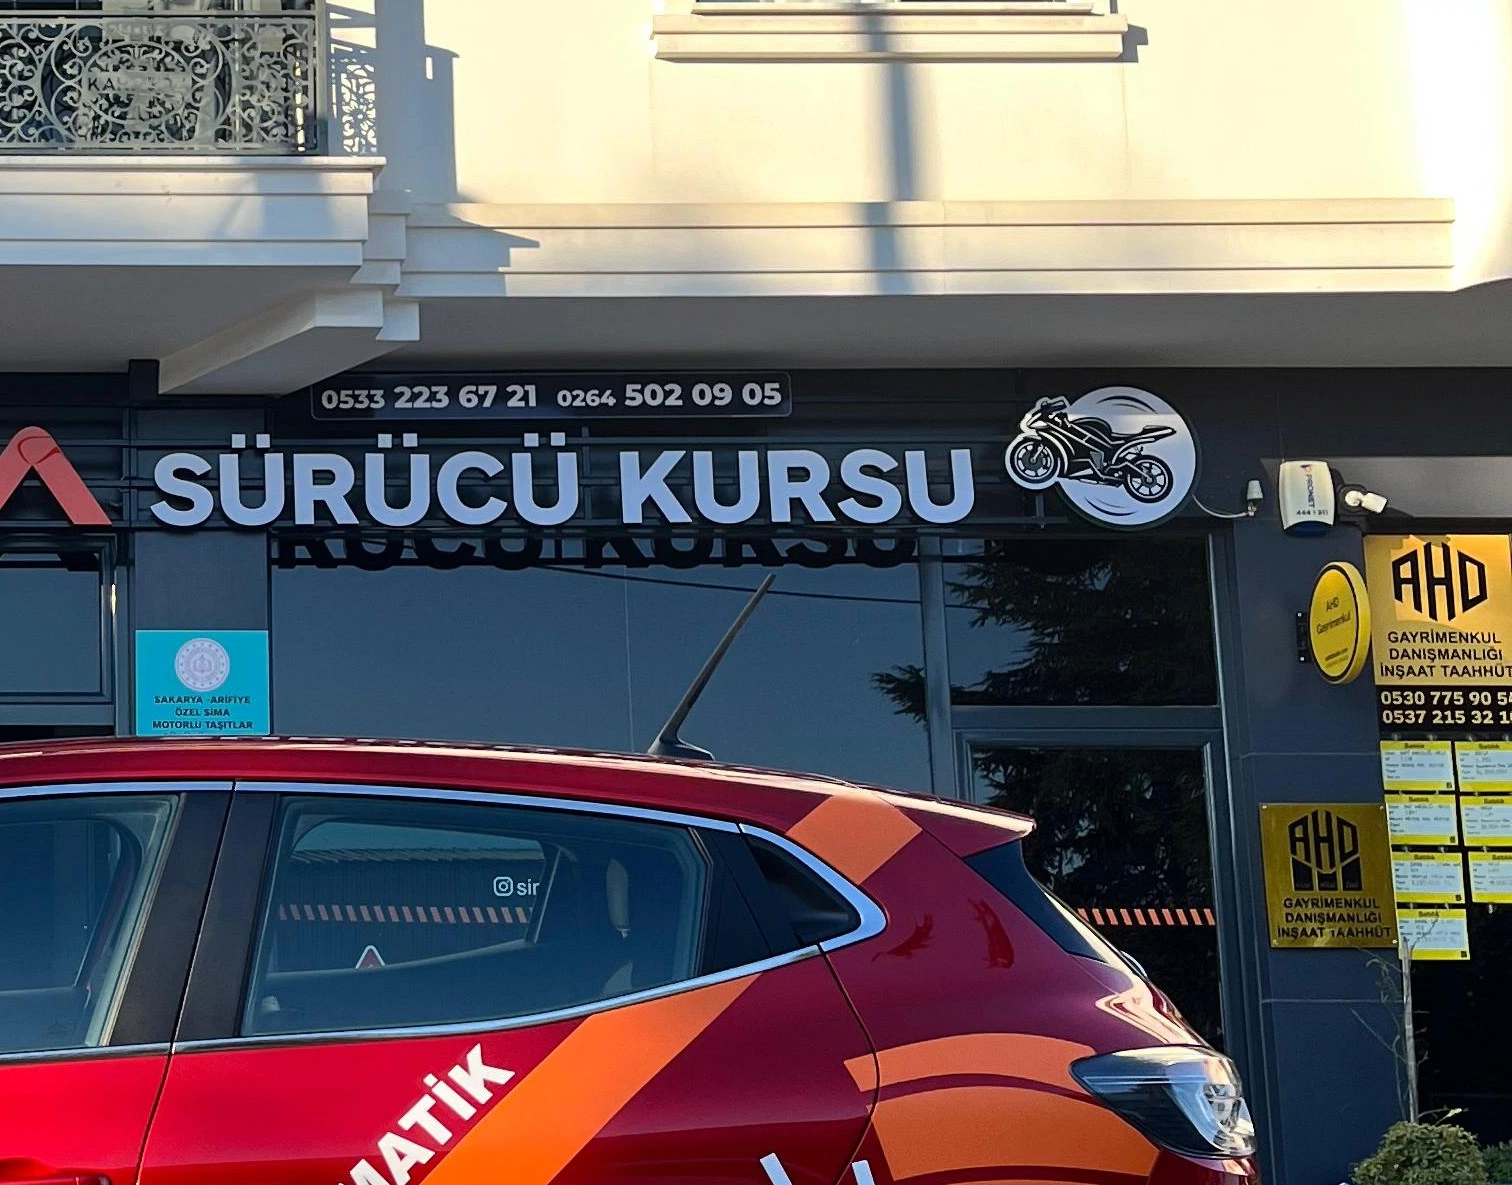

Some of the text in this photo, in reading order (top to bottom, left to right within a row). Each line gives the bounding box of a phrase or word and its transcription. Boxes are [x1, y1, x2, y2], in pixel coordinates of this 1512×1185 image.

[321, 382, 782, 409] 0533 223 67 21 0264 502 09 05
[149, 433, 580, 527] SÜRÜCÜ
[619, 448, 977, 525] KURSU
[1387, 629, 1502, 644] GAYRİMENKUL
[1389, 646, 1503, 662] DANIŞMANLIĞI
[1380, 662, 1436, 679] İNŞAAT
[154, 696, 203, 704] SAKARYA
[1380, 691, 1425, 705] 0530
[1430, 691, 1464, 705] 775
[1469, 691, 1492, 705] 90
[175, 707, 200, 717] ÖZEL
[1382, 710, 1427, 724] 0537
[1432, 710, 1466, 724] 215
[1471, 710, 1494, 724] 32
[152, 721, 254, 731] MOTORLU TAŞITLAR
[1283, 896, 1381, 909] GAYRİMENKUL
[1285, 911, 1382, 925] DANIŞMANLIĞI
[1277, 925, 1325, 939] İNŞAAT
